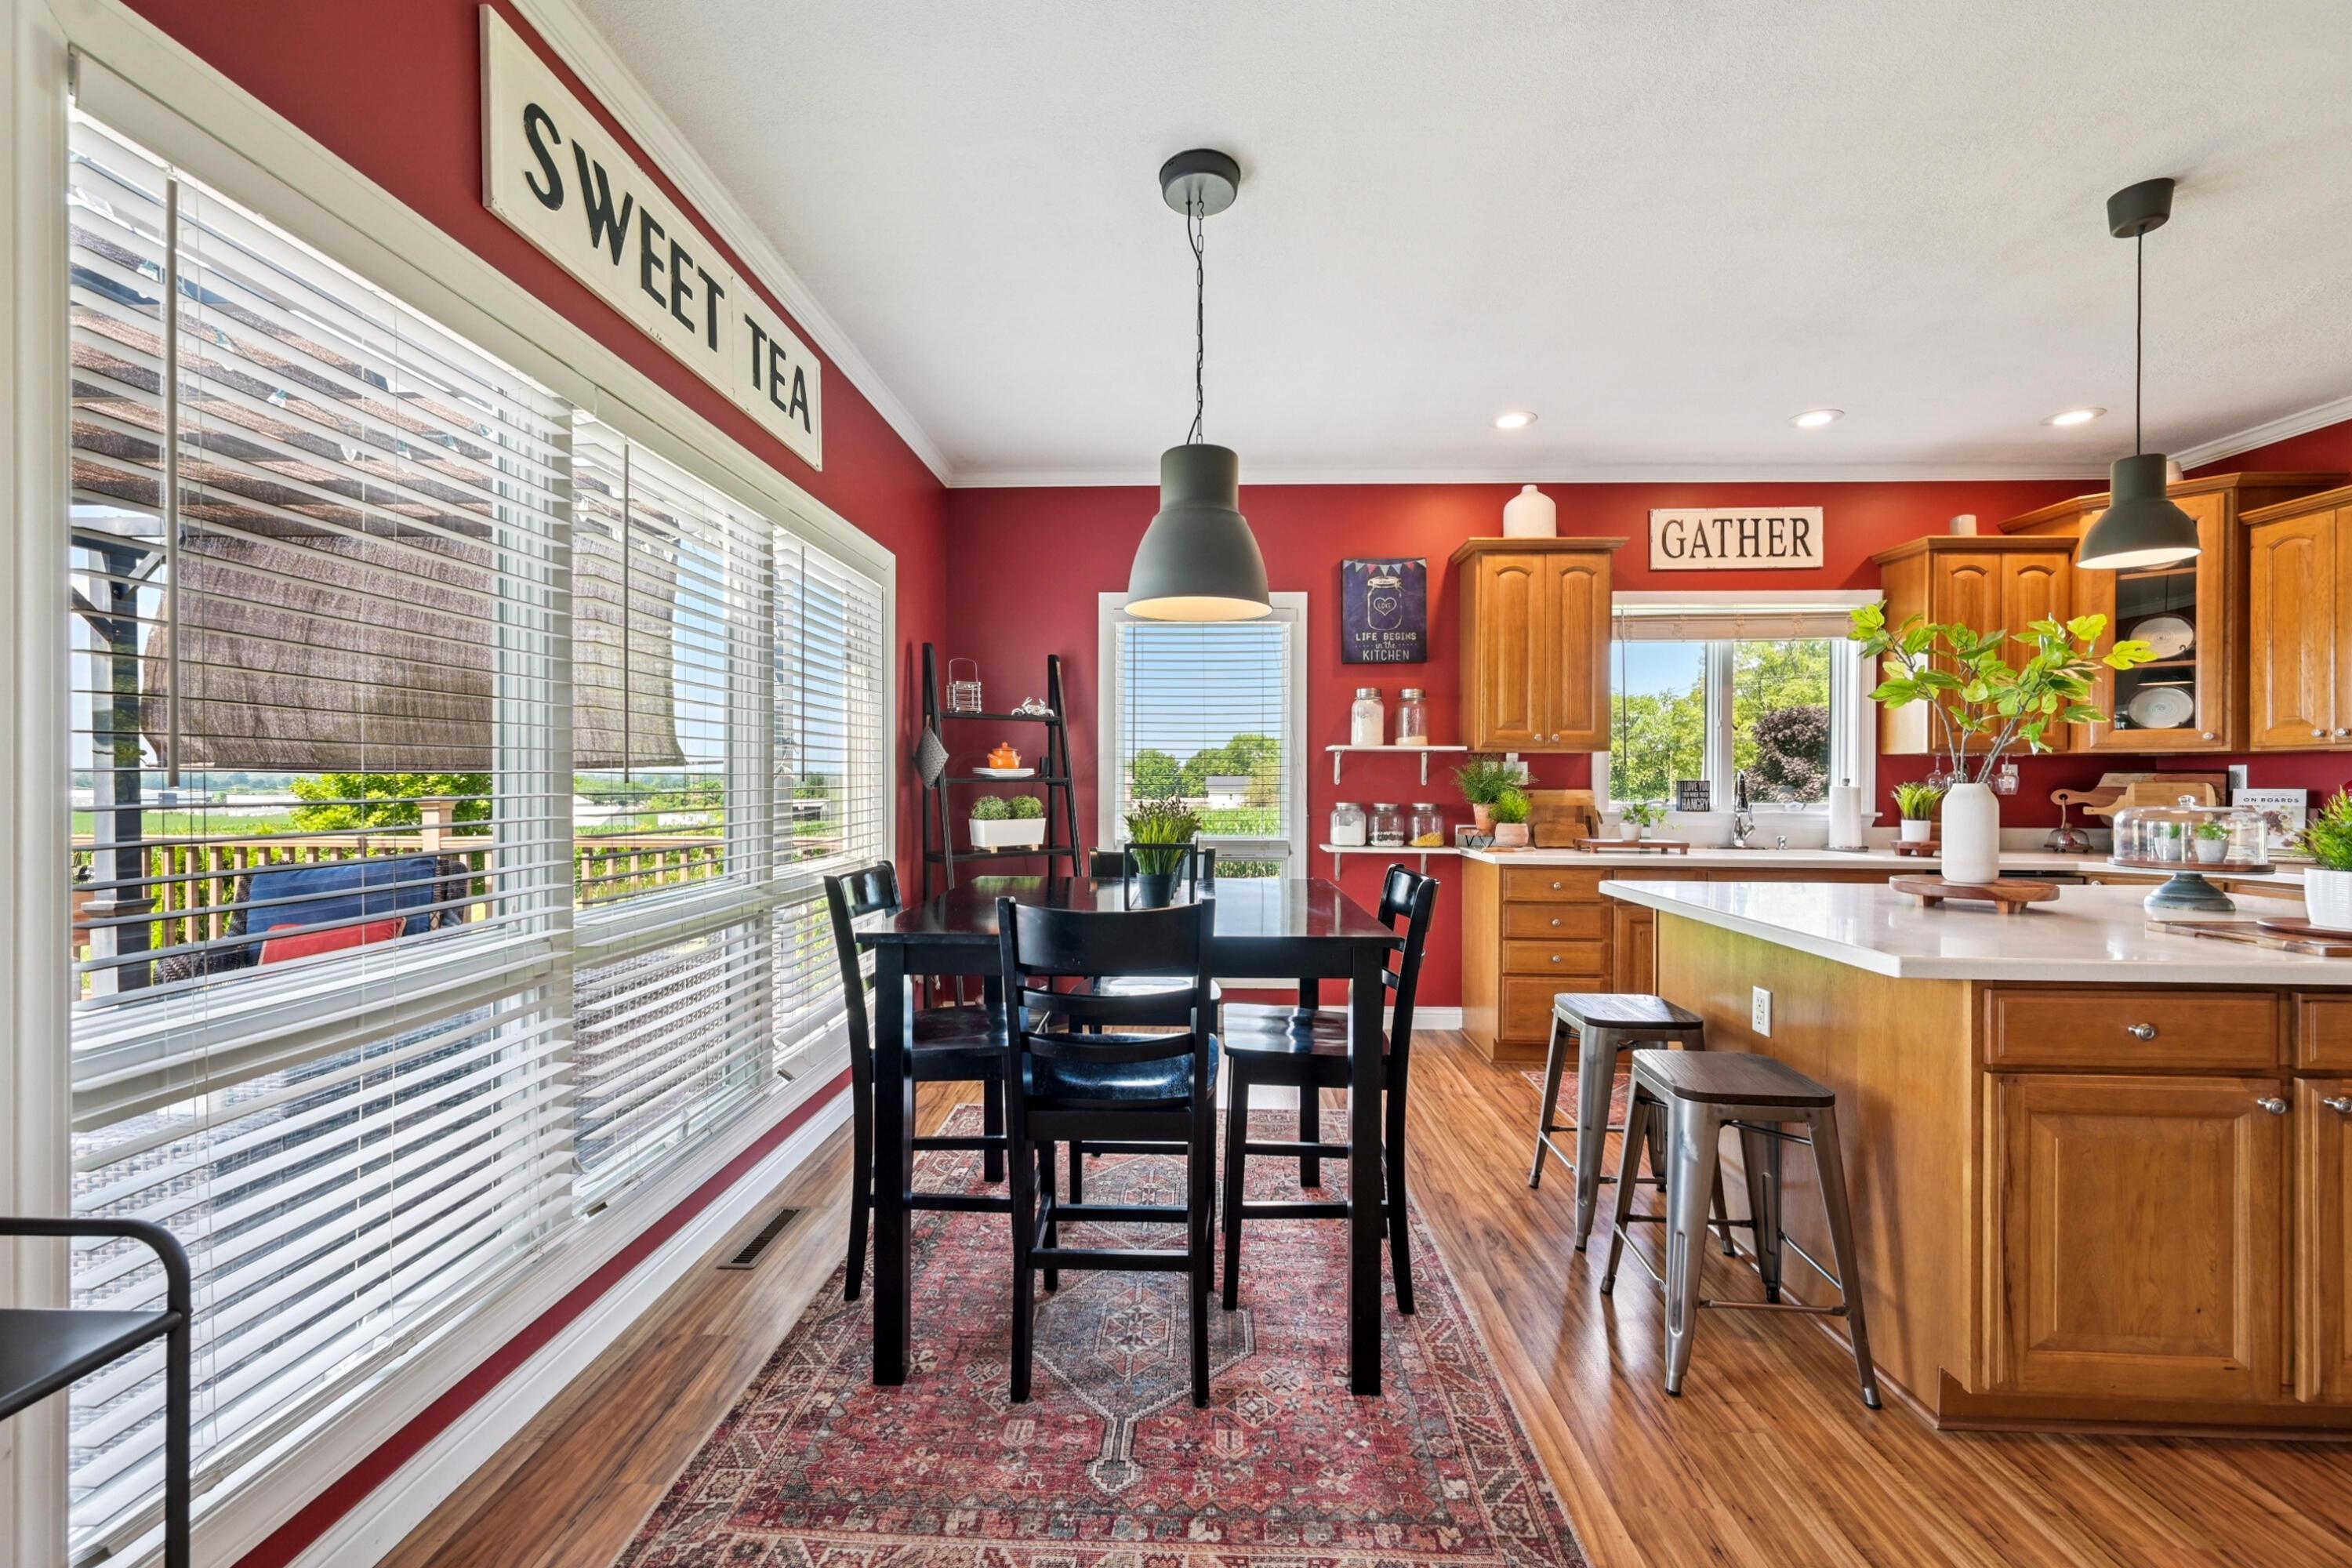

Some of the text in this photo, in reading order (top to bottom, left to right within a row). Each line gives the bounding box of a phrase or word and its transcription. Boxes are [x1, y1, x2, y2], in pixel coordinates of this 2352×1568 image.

[523, 101, 811, 434] SWEET TEA
[1661, 517, 1813, 559] GATHER
[1356, 632, 1417, 641] LIFE BEGINS
[1383, 641, 1396, 649] the
[1363, 649, 1410, 661] KITCHEN
[1684, 782, 1698, 791] LOVE
[1698, 782, 1710, 791] YOU
[1682, 798, 1710, 811] HANGRY
